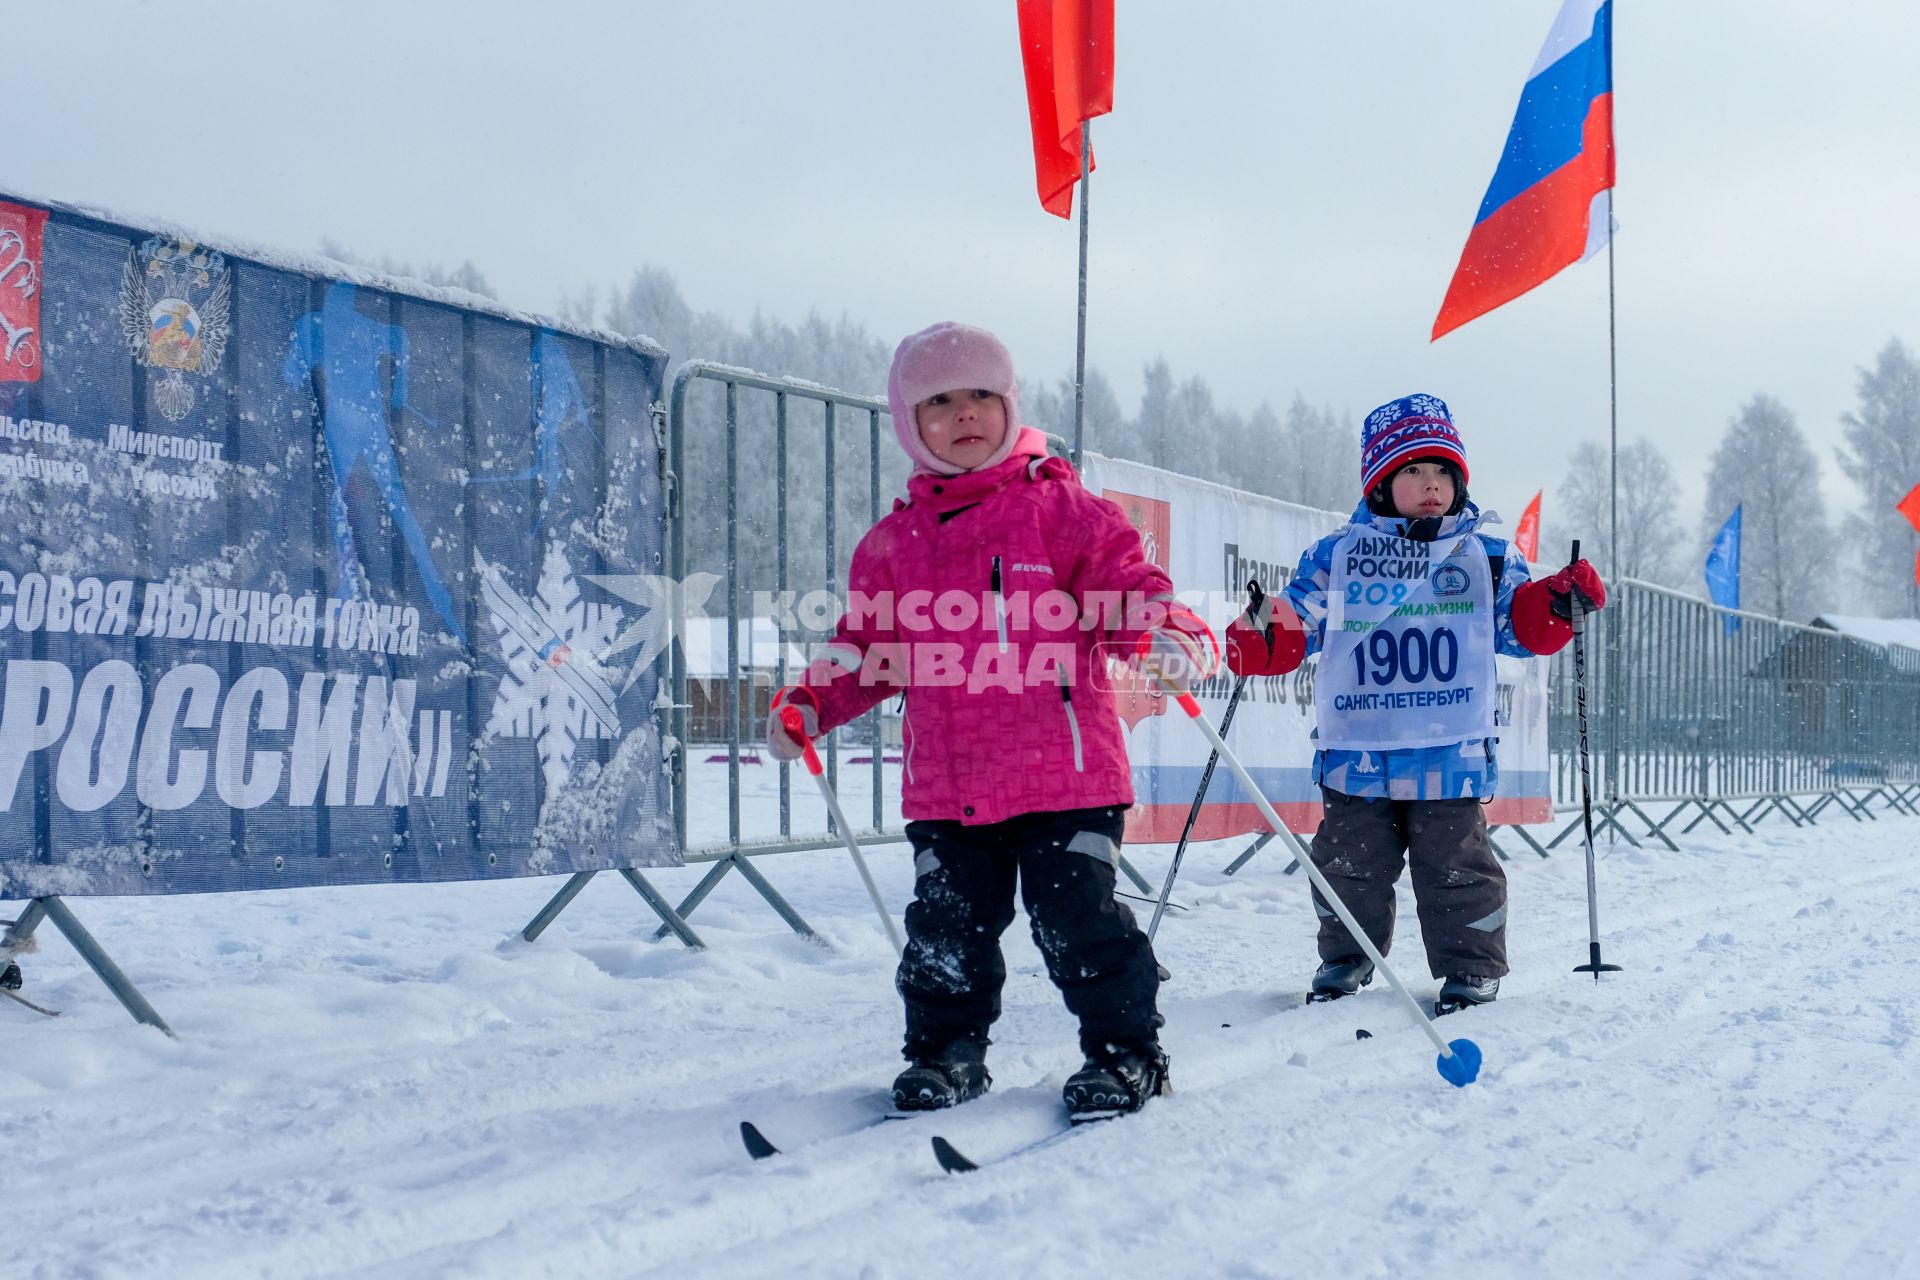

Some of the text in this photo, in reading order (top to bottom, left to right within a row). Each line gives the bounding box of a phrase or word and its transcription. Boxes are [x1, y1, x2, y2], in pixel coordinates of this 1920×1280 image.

[107, 423, 224, 463] Минспорт
[1346, 537, 1430, 558] ЛЫЖНЯ
[1346, 557, 1430, 580] РОССИИ
[1345, 581, 1408, 606] 202
[134, 583, 318, 648] лыжная
[322, 597, 420, 656] гонка
[1425, 601, 1474, 616] ЖИЗНИ
[1352, 626, 1459, 687] 1900
[1334, 686, 1474, 711] САНКТ-ПЕТЕРБУРГ
